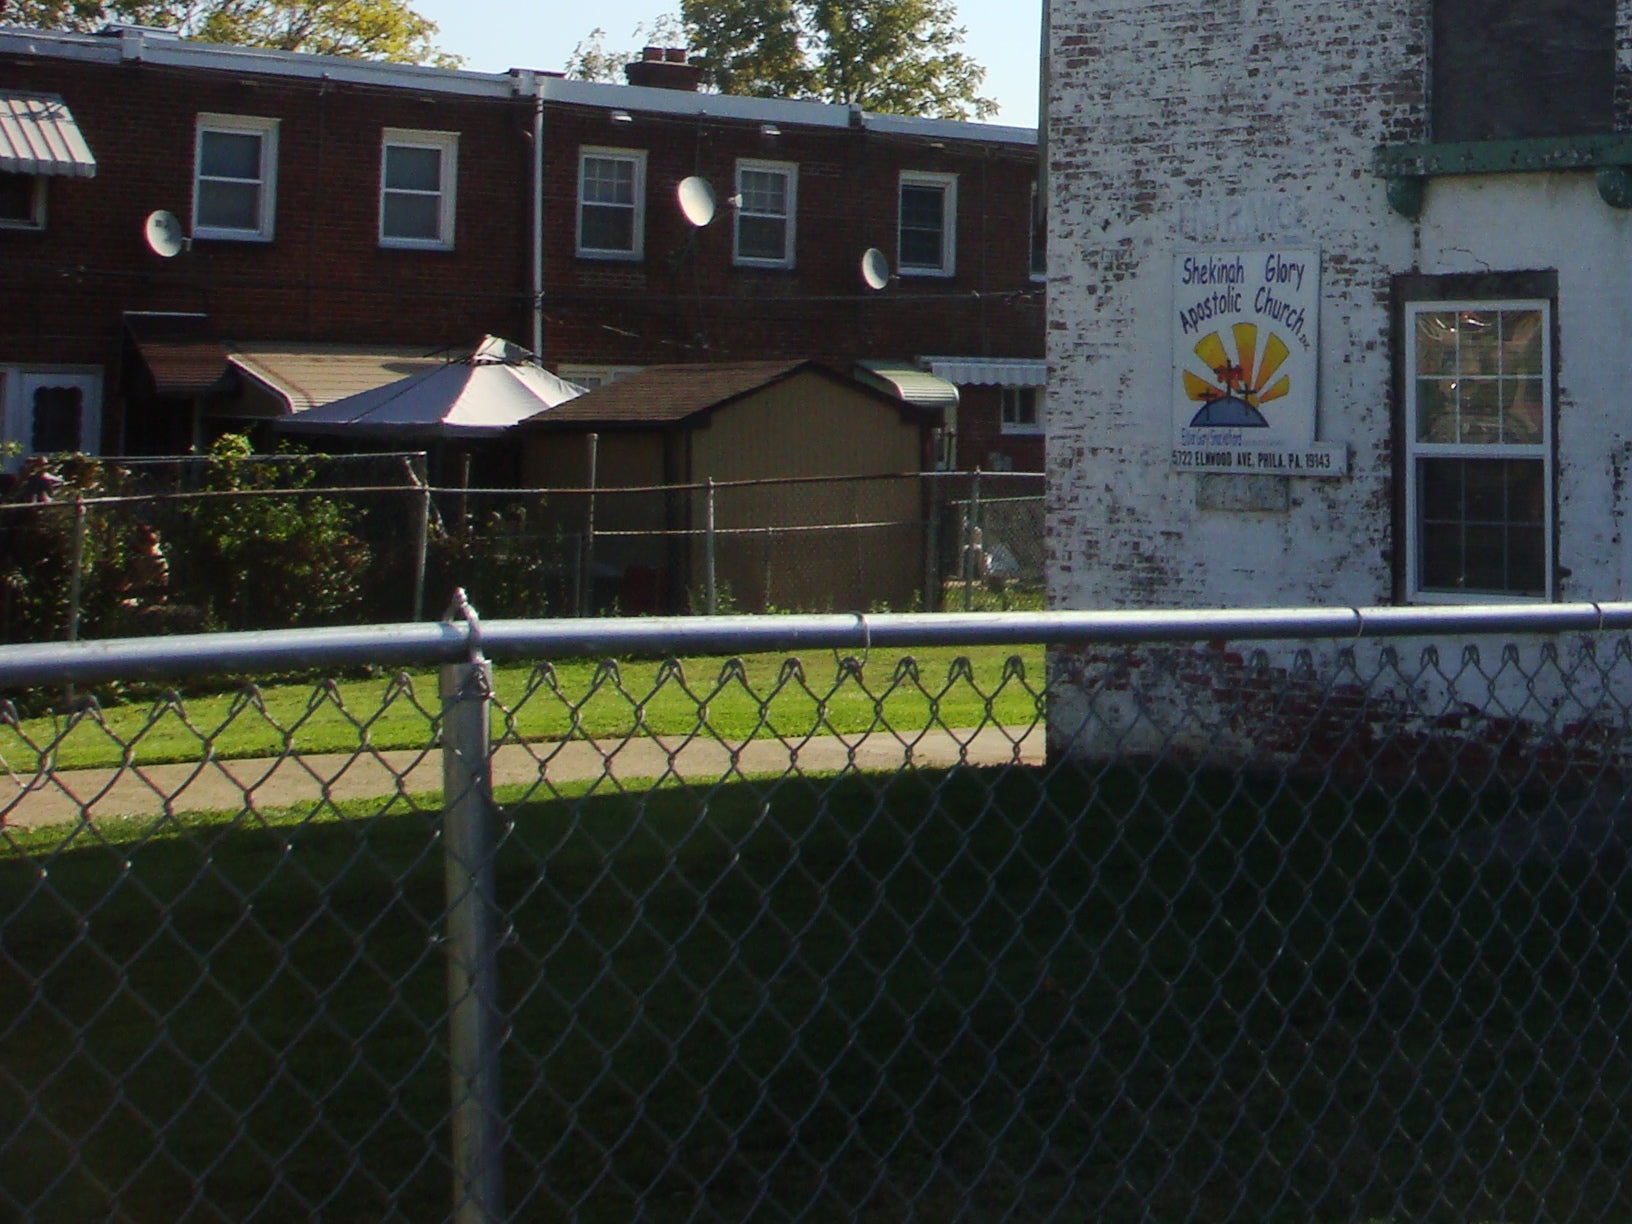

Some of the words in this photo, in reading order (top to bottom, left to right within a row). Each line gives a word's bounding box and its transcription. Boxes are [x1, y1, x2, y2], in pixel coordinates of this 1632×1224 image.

[1182, 256, 1245, 285] Shekinah
[1265, 254, 1305, 292] Glory
[1180, 285, 1242, 335] Apostolic
[1254, 286, 1306, 336] Church
[1171, 450, 1192, 467] 5722
[1195, 451, 1232, 467] ELMWOOD
[1305, 453, 1330, 468] 19143
